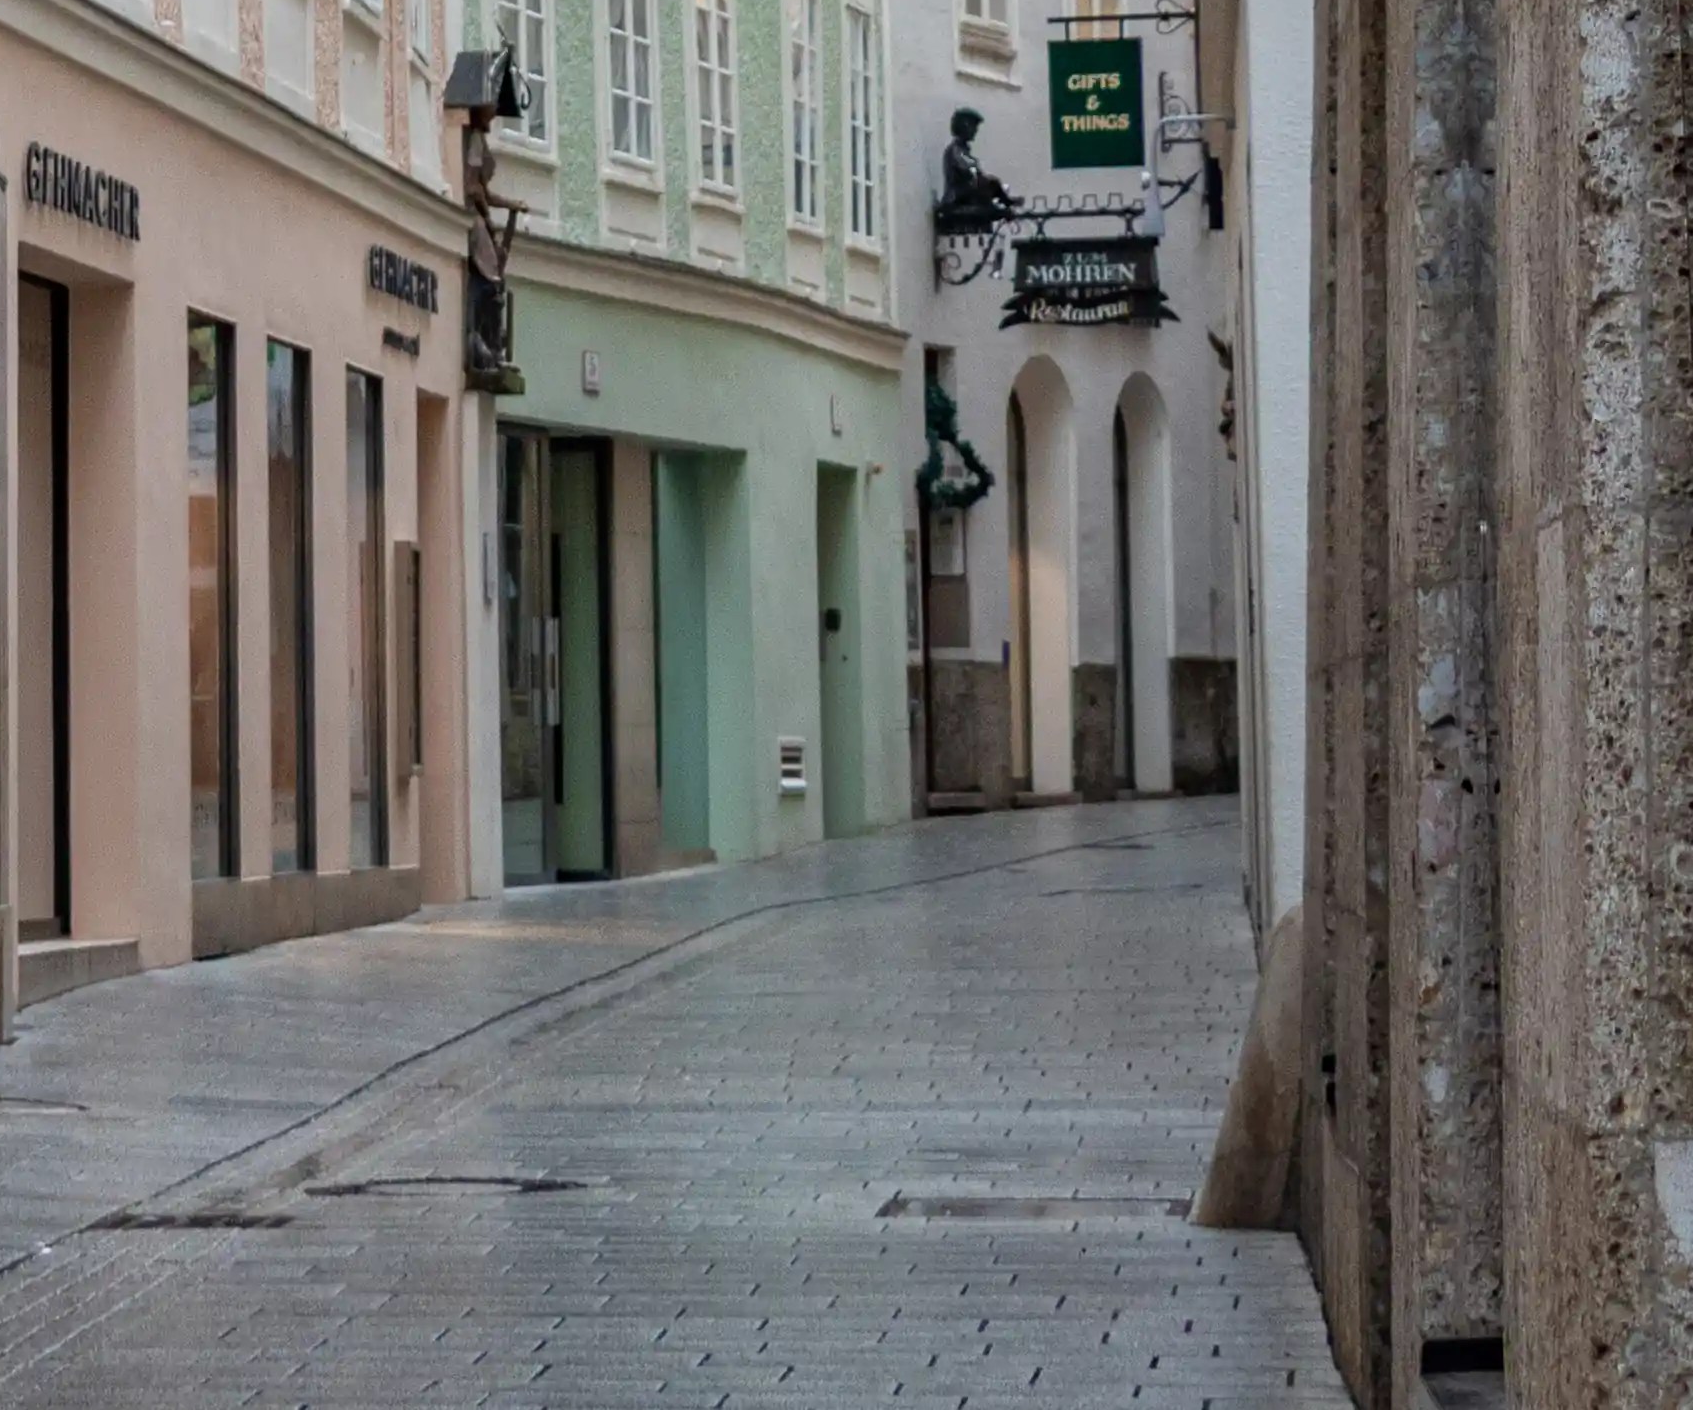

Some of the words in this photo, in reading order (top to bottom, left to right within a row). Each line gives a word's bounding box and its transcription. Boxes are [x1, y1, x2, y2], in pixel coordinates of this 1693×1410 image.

[1067, 72, 1121, 91] GIFTS
[1060, 112, 1130, 133] THINGS
[26, 140, 141, 242] GEHMACHER
[1025, 262, 1137, 284] MOHREN
